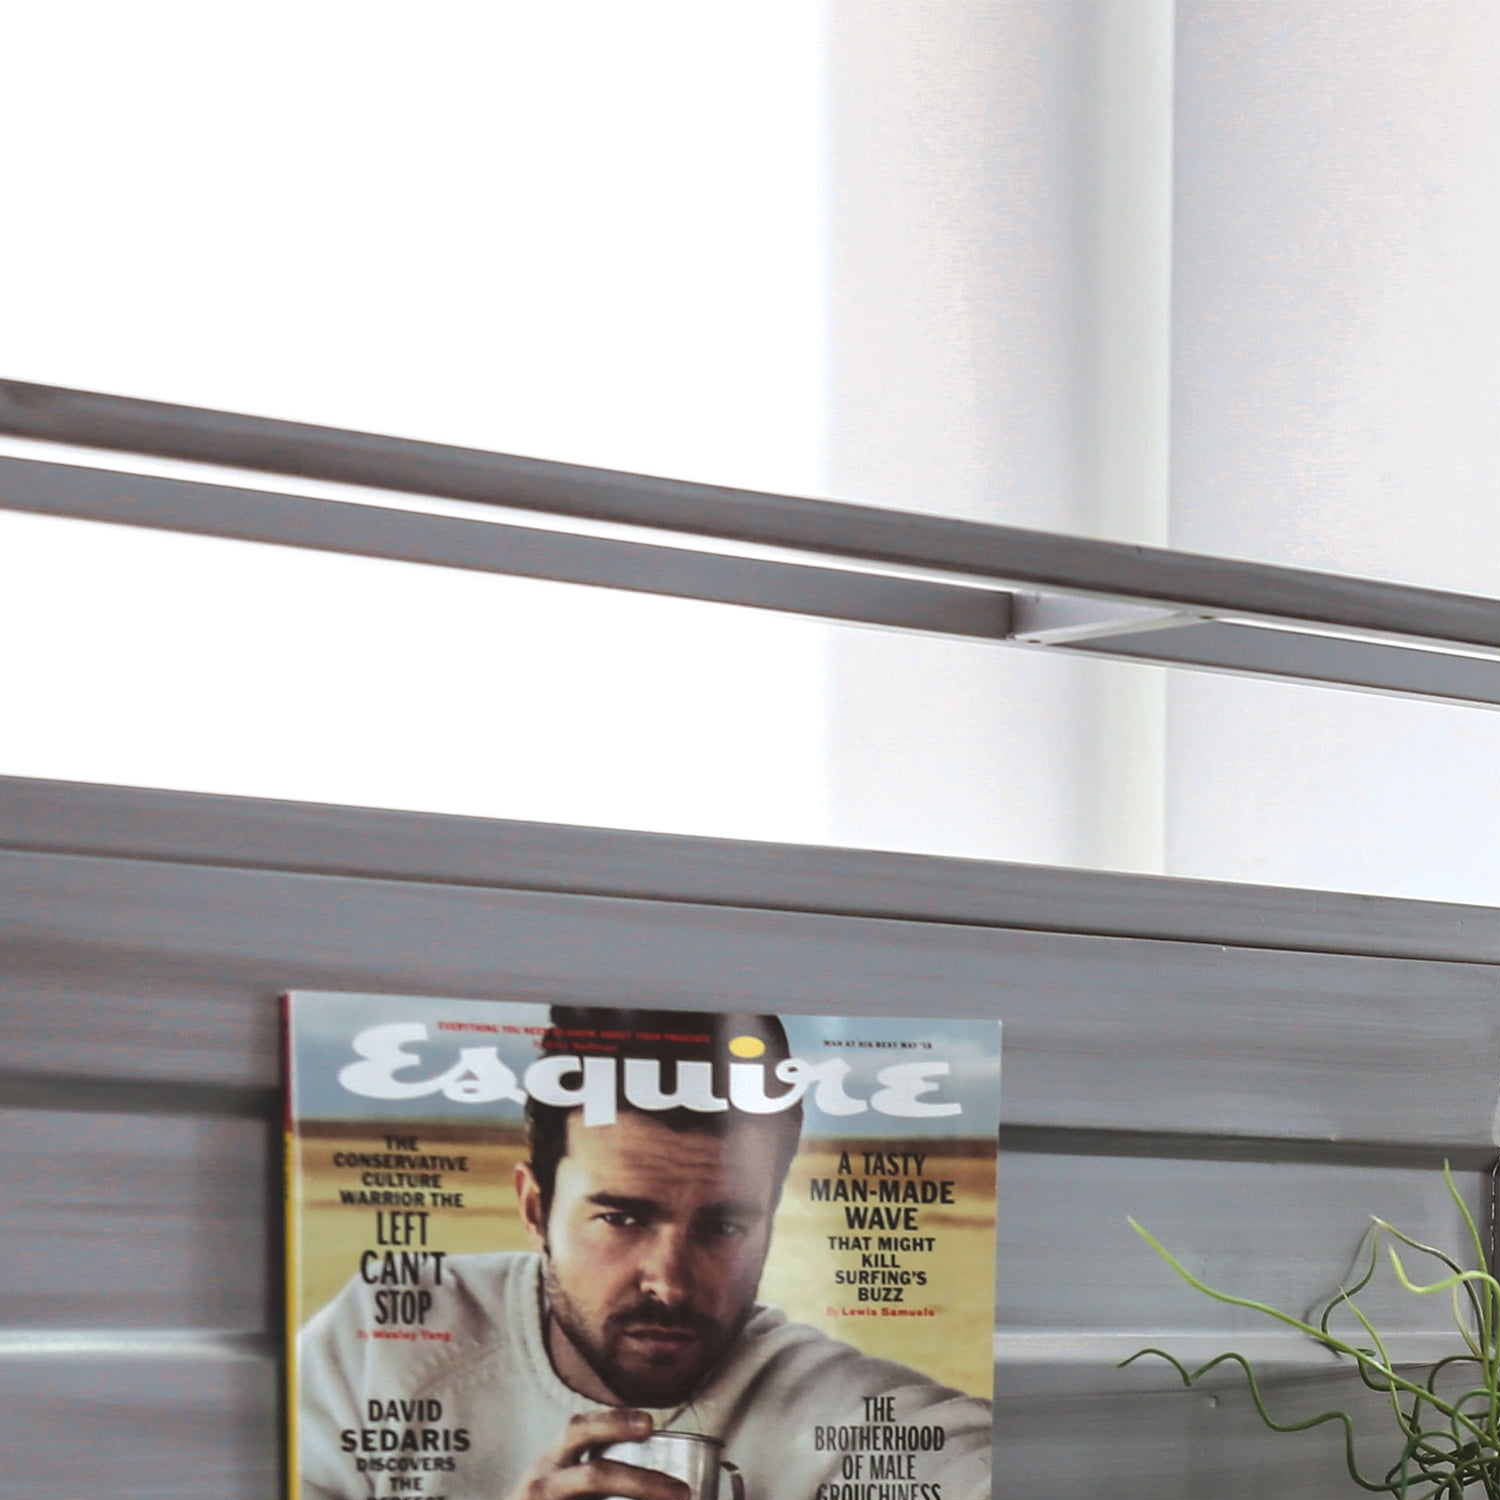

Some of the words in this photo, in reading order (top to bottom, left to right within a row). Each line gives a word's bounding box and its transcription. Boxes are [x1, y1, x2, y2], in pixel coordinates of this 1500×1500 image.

[338, 1020, 962, 1127] Esquire
[384, 1136, 419, 1151] THE
[333, 1152, 469, 1171] CONSERVATIVE
[838, 1152, 851, 1175] A
[862, 1152, 927, 1176] TASTY
[362, 1172, 442, 1188] CULTURE
[810, 1178, 955, 1204] MAN-MADE
[339, 1189, 425, 1207] WARRIOR
[429, 1192, 464, 1208] THE
[376, 1211, 429, 1245] LEFT
[845, 1207, 918, 1230] WAVE
[828, 1236, 872, 1250] THAT
[878, 1237, 936, 1252] MIGHT
[361, 1250, 446, 1285] CAN'T
[862, 1254, 900, 1268] KILL
[835, 1270, 927, 1286] SURFING'S
[858, 1288, 903, 1302] BUZZ
[375, 1290, 432, 1325] STOP
[842, 1307, 877, 1317] Lewis
[881, 1307, 935, 1317] Samuels
[368, 1399, 442, 1422] DAVID
[863, 1396, 896, 1422] THE
[341, 1429, 470, 1452] SEDARIS
[814, 1425, 945, 1451] BROTHERHOOD
[356, 1457, 456, 1472] DISCOVERS
[842, 1455, 864, 1480] OF
[870, 1455, 916, 1480] MALE
[389, 1477, 424, 1491] THE
